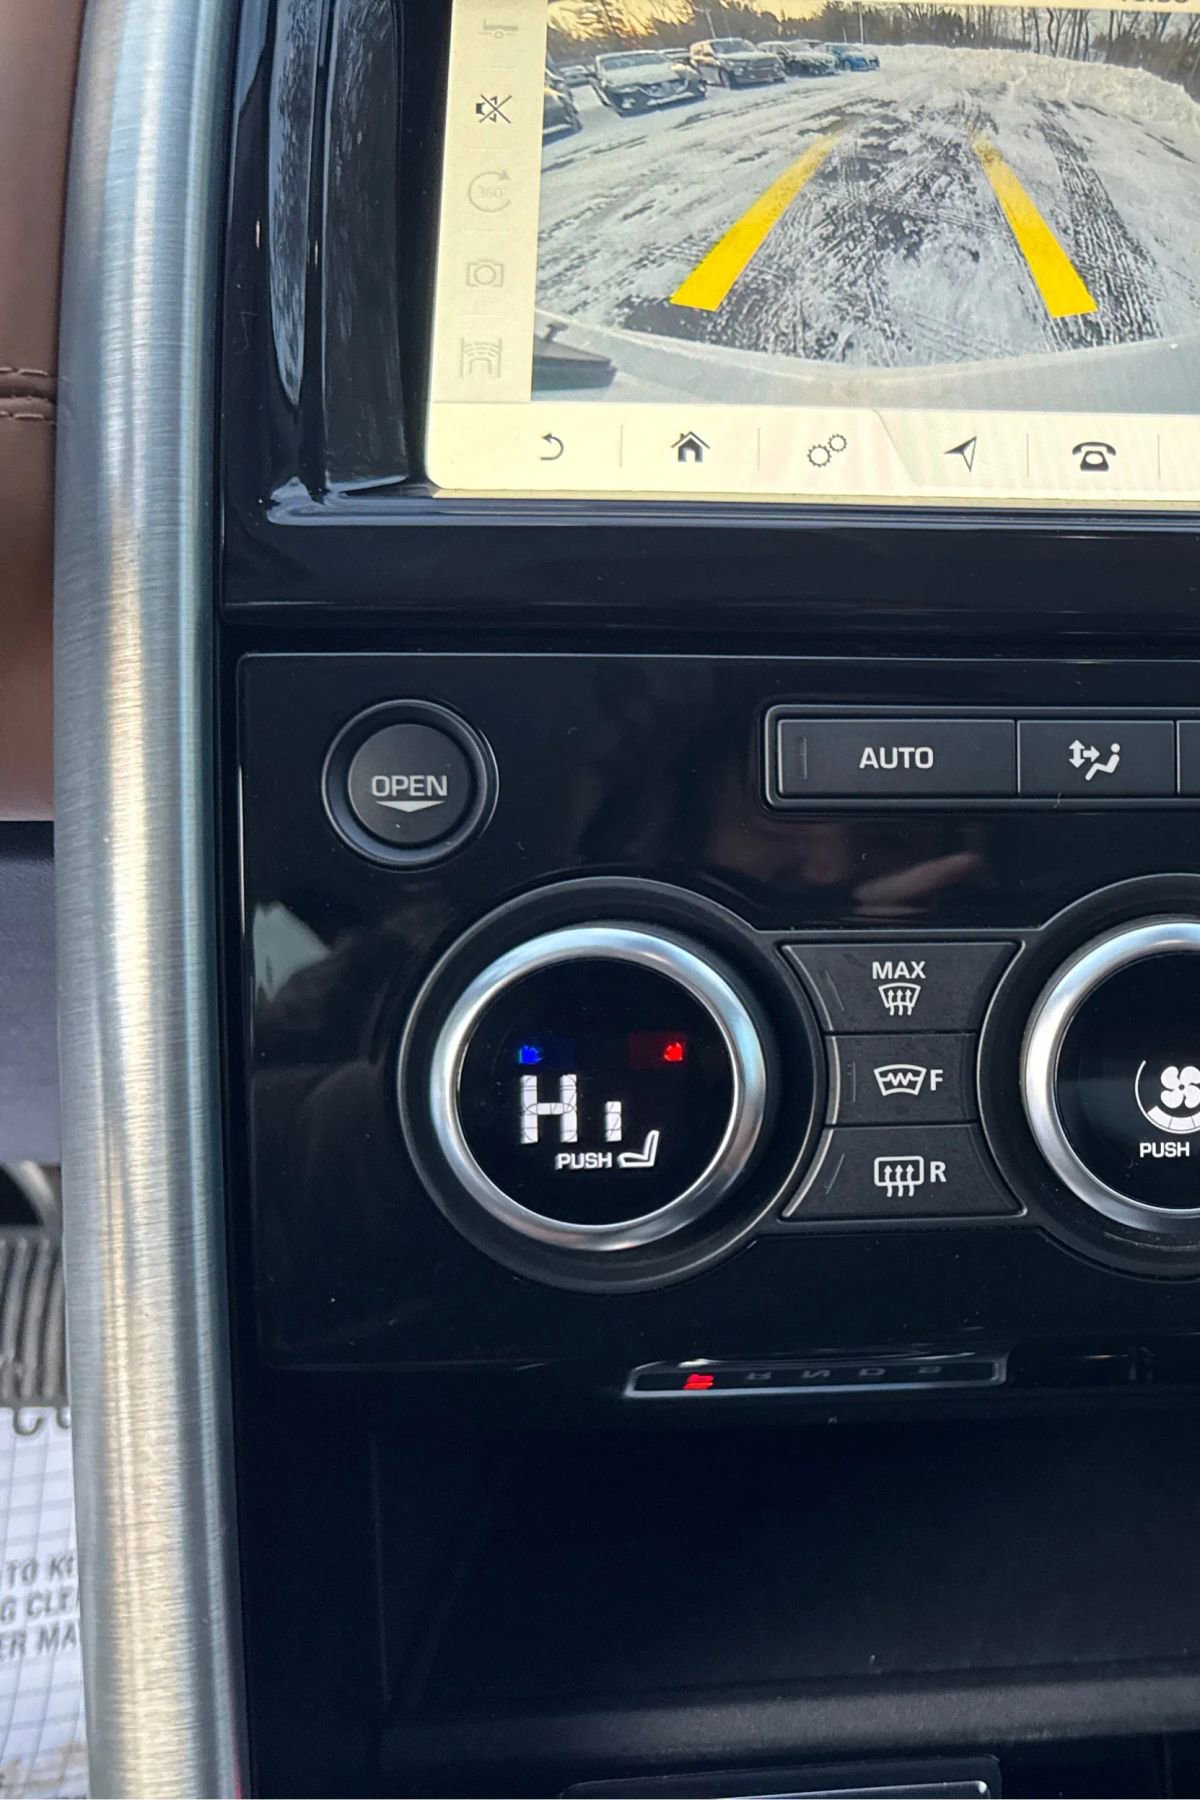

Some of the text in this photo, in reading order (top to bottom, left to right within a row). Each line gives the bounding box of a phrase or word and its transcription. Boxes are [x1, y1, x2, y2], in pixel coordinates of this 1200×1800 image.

[859, 746, 934, 769] AUTO
[371, 775, 448, 798] OPEN
[872, 960, 926, 980] MAX
[930, 1069, 944, 1091] F
[555, 1151, 613, 1170] PUSH
[1139, 1141, 1190, 1158] PUSH
[930, 1160, 947, 1183] R
